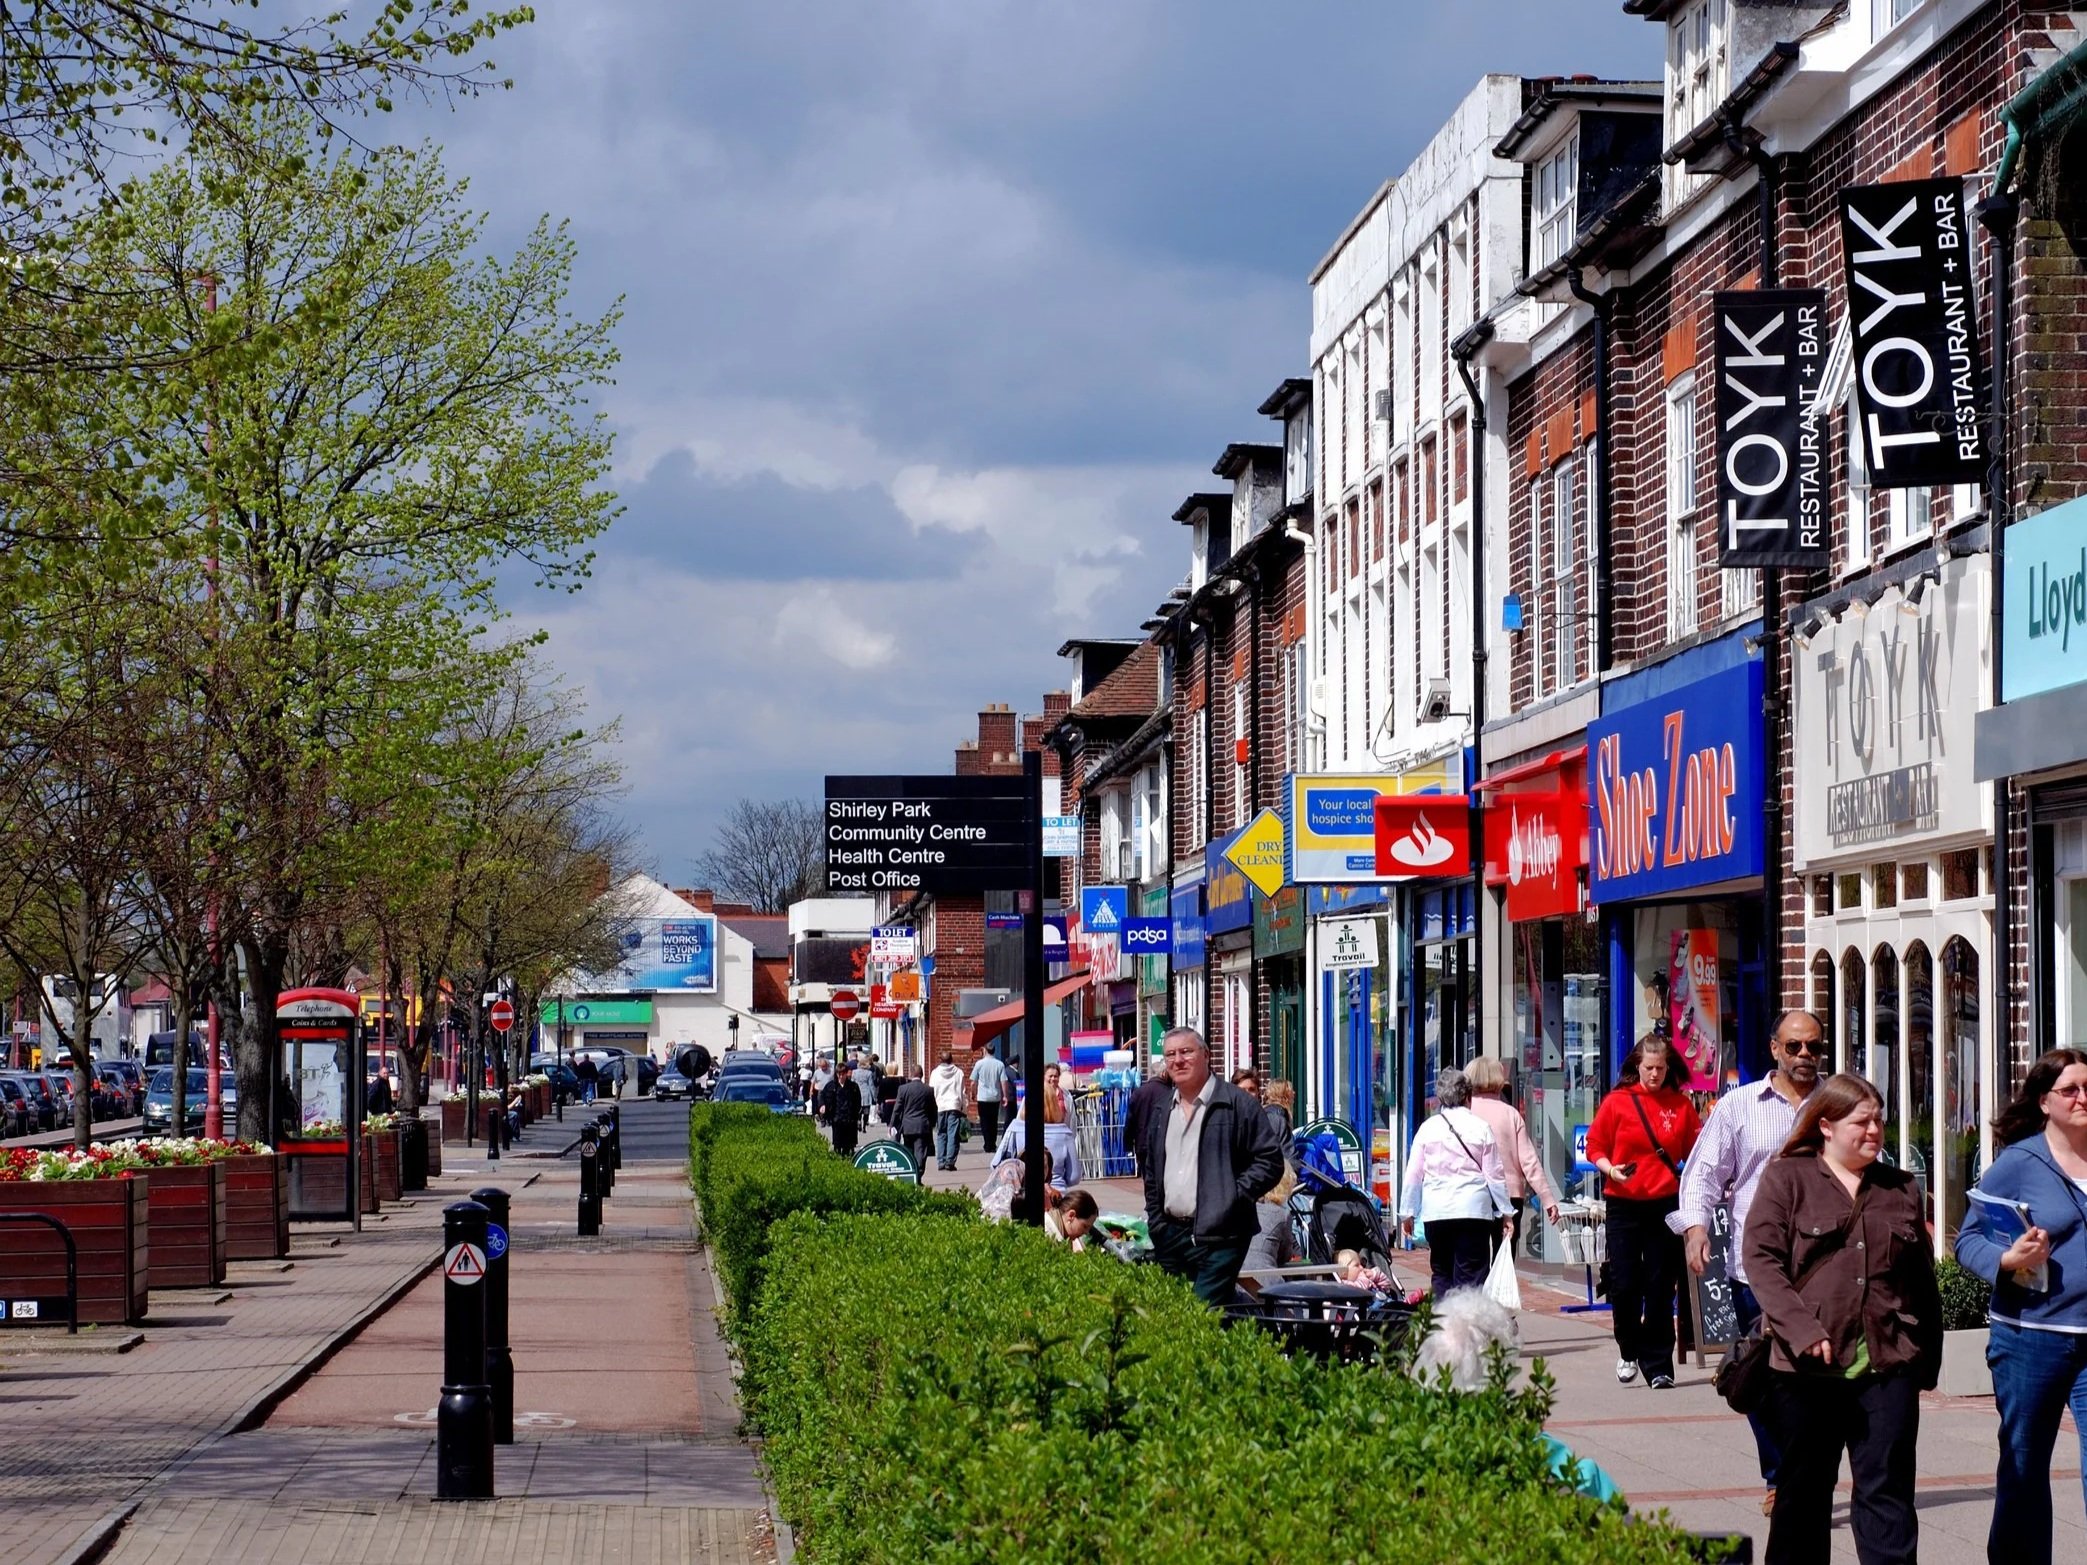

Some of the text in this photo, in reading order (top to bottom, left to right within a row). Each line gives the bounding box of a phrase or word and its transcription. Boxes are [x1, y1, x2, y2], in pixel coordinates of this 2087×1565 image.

[1935, 193, 1959, 249] BAR
[1798, 305, 1818, 355] BAR
[1848, 196, 1940, 469] TOYK
[1942, 281, 1980, 460] RESTAURANT
[1725, 311, 1788, 549] TOYK
[1799, 385, 1820, 547] RESTAURANT
[2029, 547, 2087, 653] Lloyd
[1818, 614, 1937, 767] TOYK
[1319, 799, 1372, 810] Your local
[1597, 710, 1736, 881] Shoe Zone
[1829, 774, 1890, 834] RESTAURANT
[829, 802, 931, 821] Shirley Park
[1312, 813, 1374, 826] hospice sho
[829, 825, 986, 843] Community Centre
[829, 848, 945, 863] Health Centre
[1257, 842, 1282, 851] DRY
[1525, 812, 1559, 890] Abbey
[829, 871, 921, 886] Post Office
[663, 936, 698, 944] WORKS
[879, 929, 907, 937] TO LET
[1127, 925, 1167, 945] pdsa
[663, 945, 702, 954] BEYOND
[663, 954, 693, 963] PASTE
[1332, 953, 1365, 961] Travail
[1694, 954, 1716, 985] 9.99
[297, 1005, 332, 1014] Telephone
